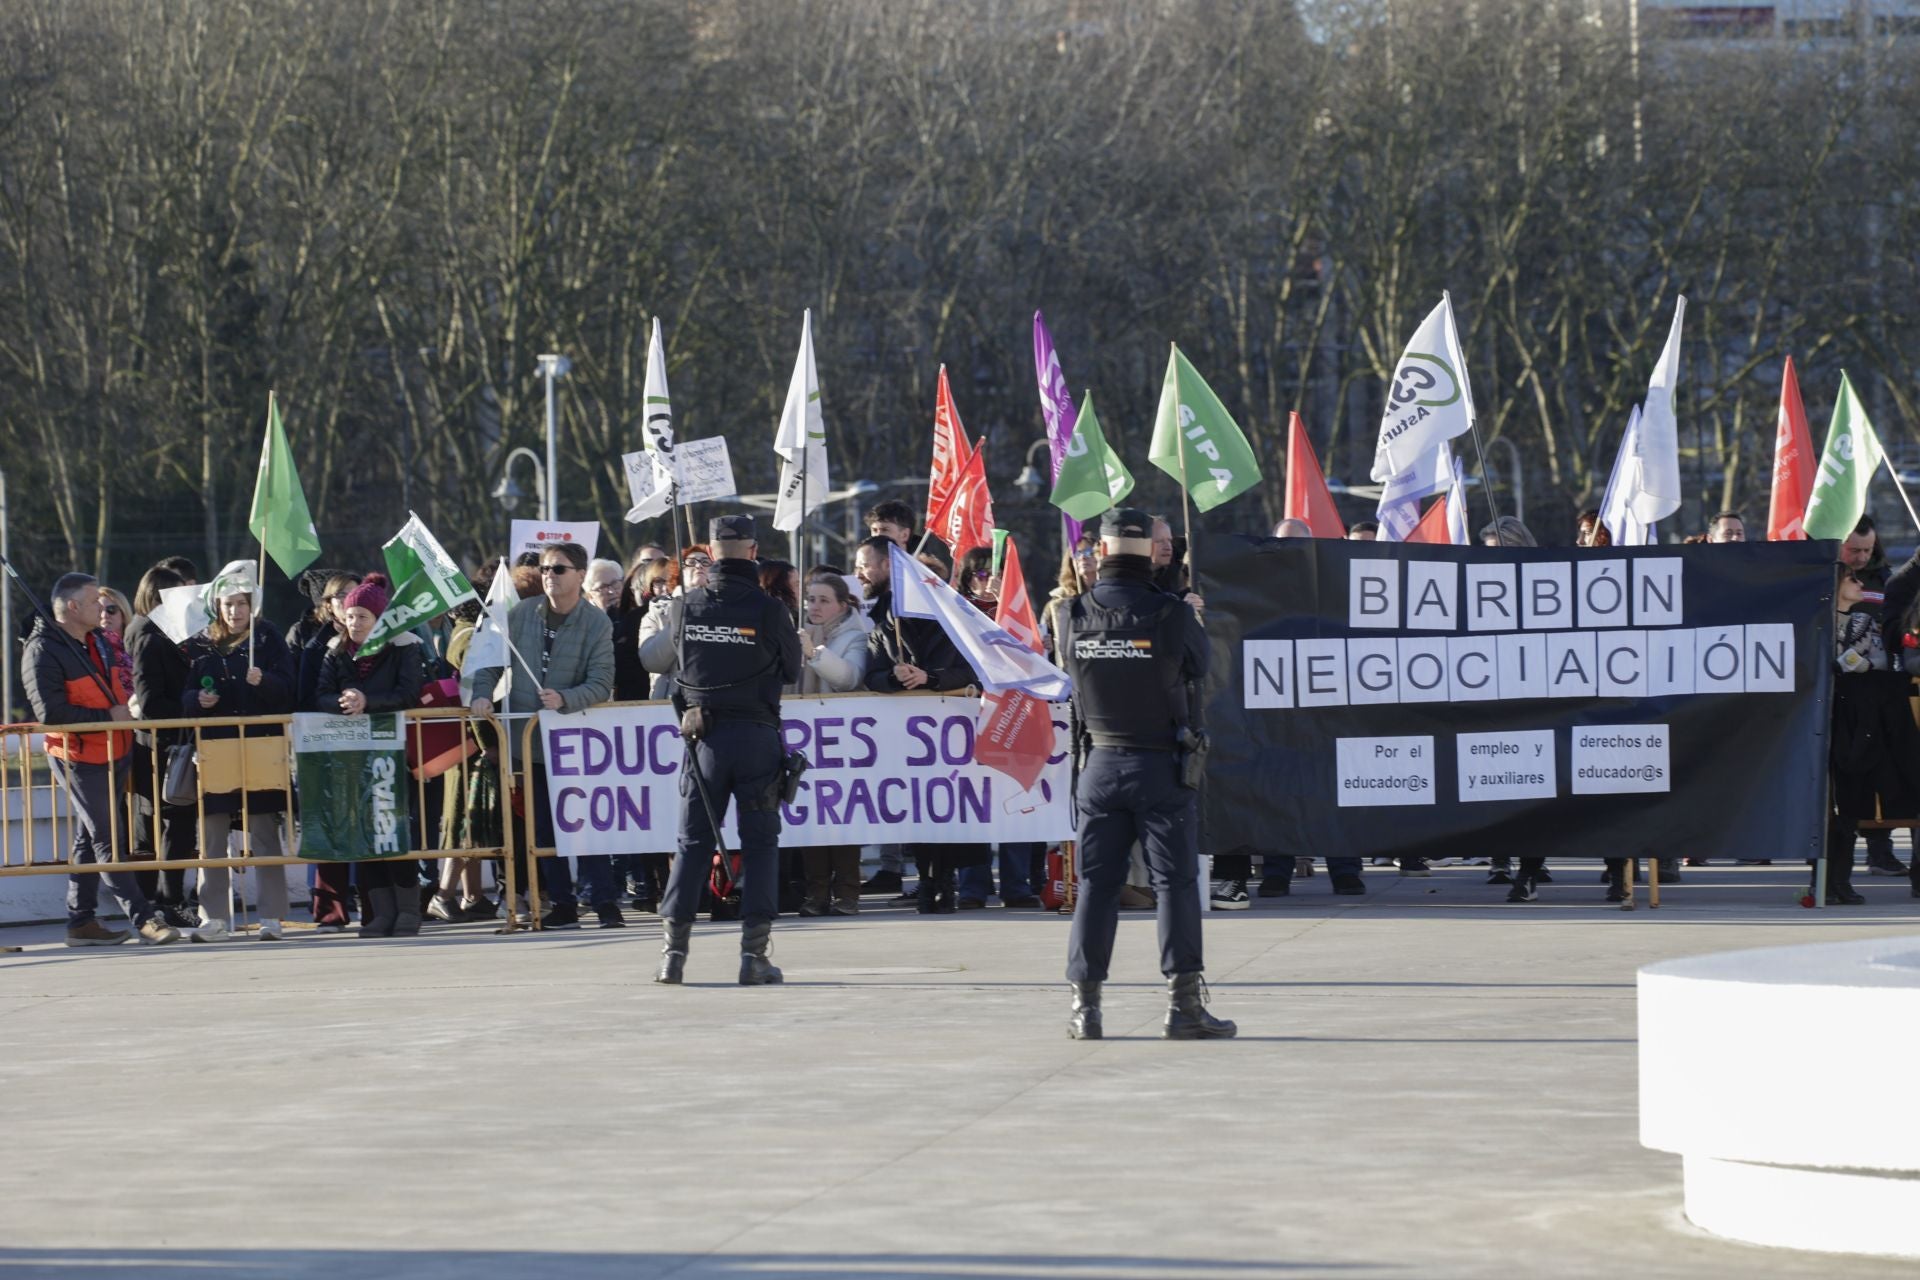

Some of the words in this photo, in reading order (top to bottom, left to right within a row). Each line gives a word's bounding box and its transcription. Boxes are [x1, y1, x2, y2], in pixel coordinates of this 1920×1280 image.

[1178, 404, 1233, 493] SIPA
[1359, 568, 1674, 618] BARBÓN
[685, 624, 740, 635] POLICIA
[685, 632, 756, 645] NACIONAL
[1075, 640, 1136, 650] POLICIA
[1075, 649, 1152, 659] NACIONAL
[1253, 635, 1786, 696] NEGOCIACIÓN
[548, 716, 877, 777] EDUCRES
[1470, 742, 1520, 758] empleo
[1535, 743, 1543, 757] y
[1579, 735, 1642, 749] derechos
[1646, 735, 1662, 749] de
[1375, 745, 1399, 758] Por
[1410, 745, 1421, 758] el
[1468, 774, 1476, 788] y
[1480, 771, 1545, 786] auxiliares
[1578, 764, 1663, 782] educador@s
[1344, 775, 1428, 792] educador@s
[556, 786, 651, 833] CON
